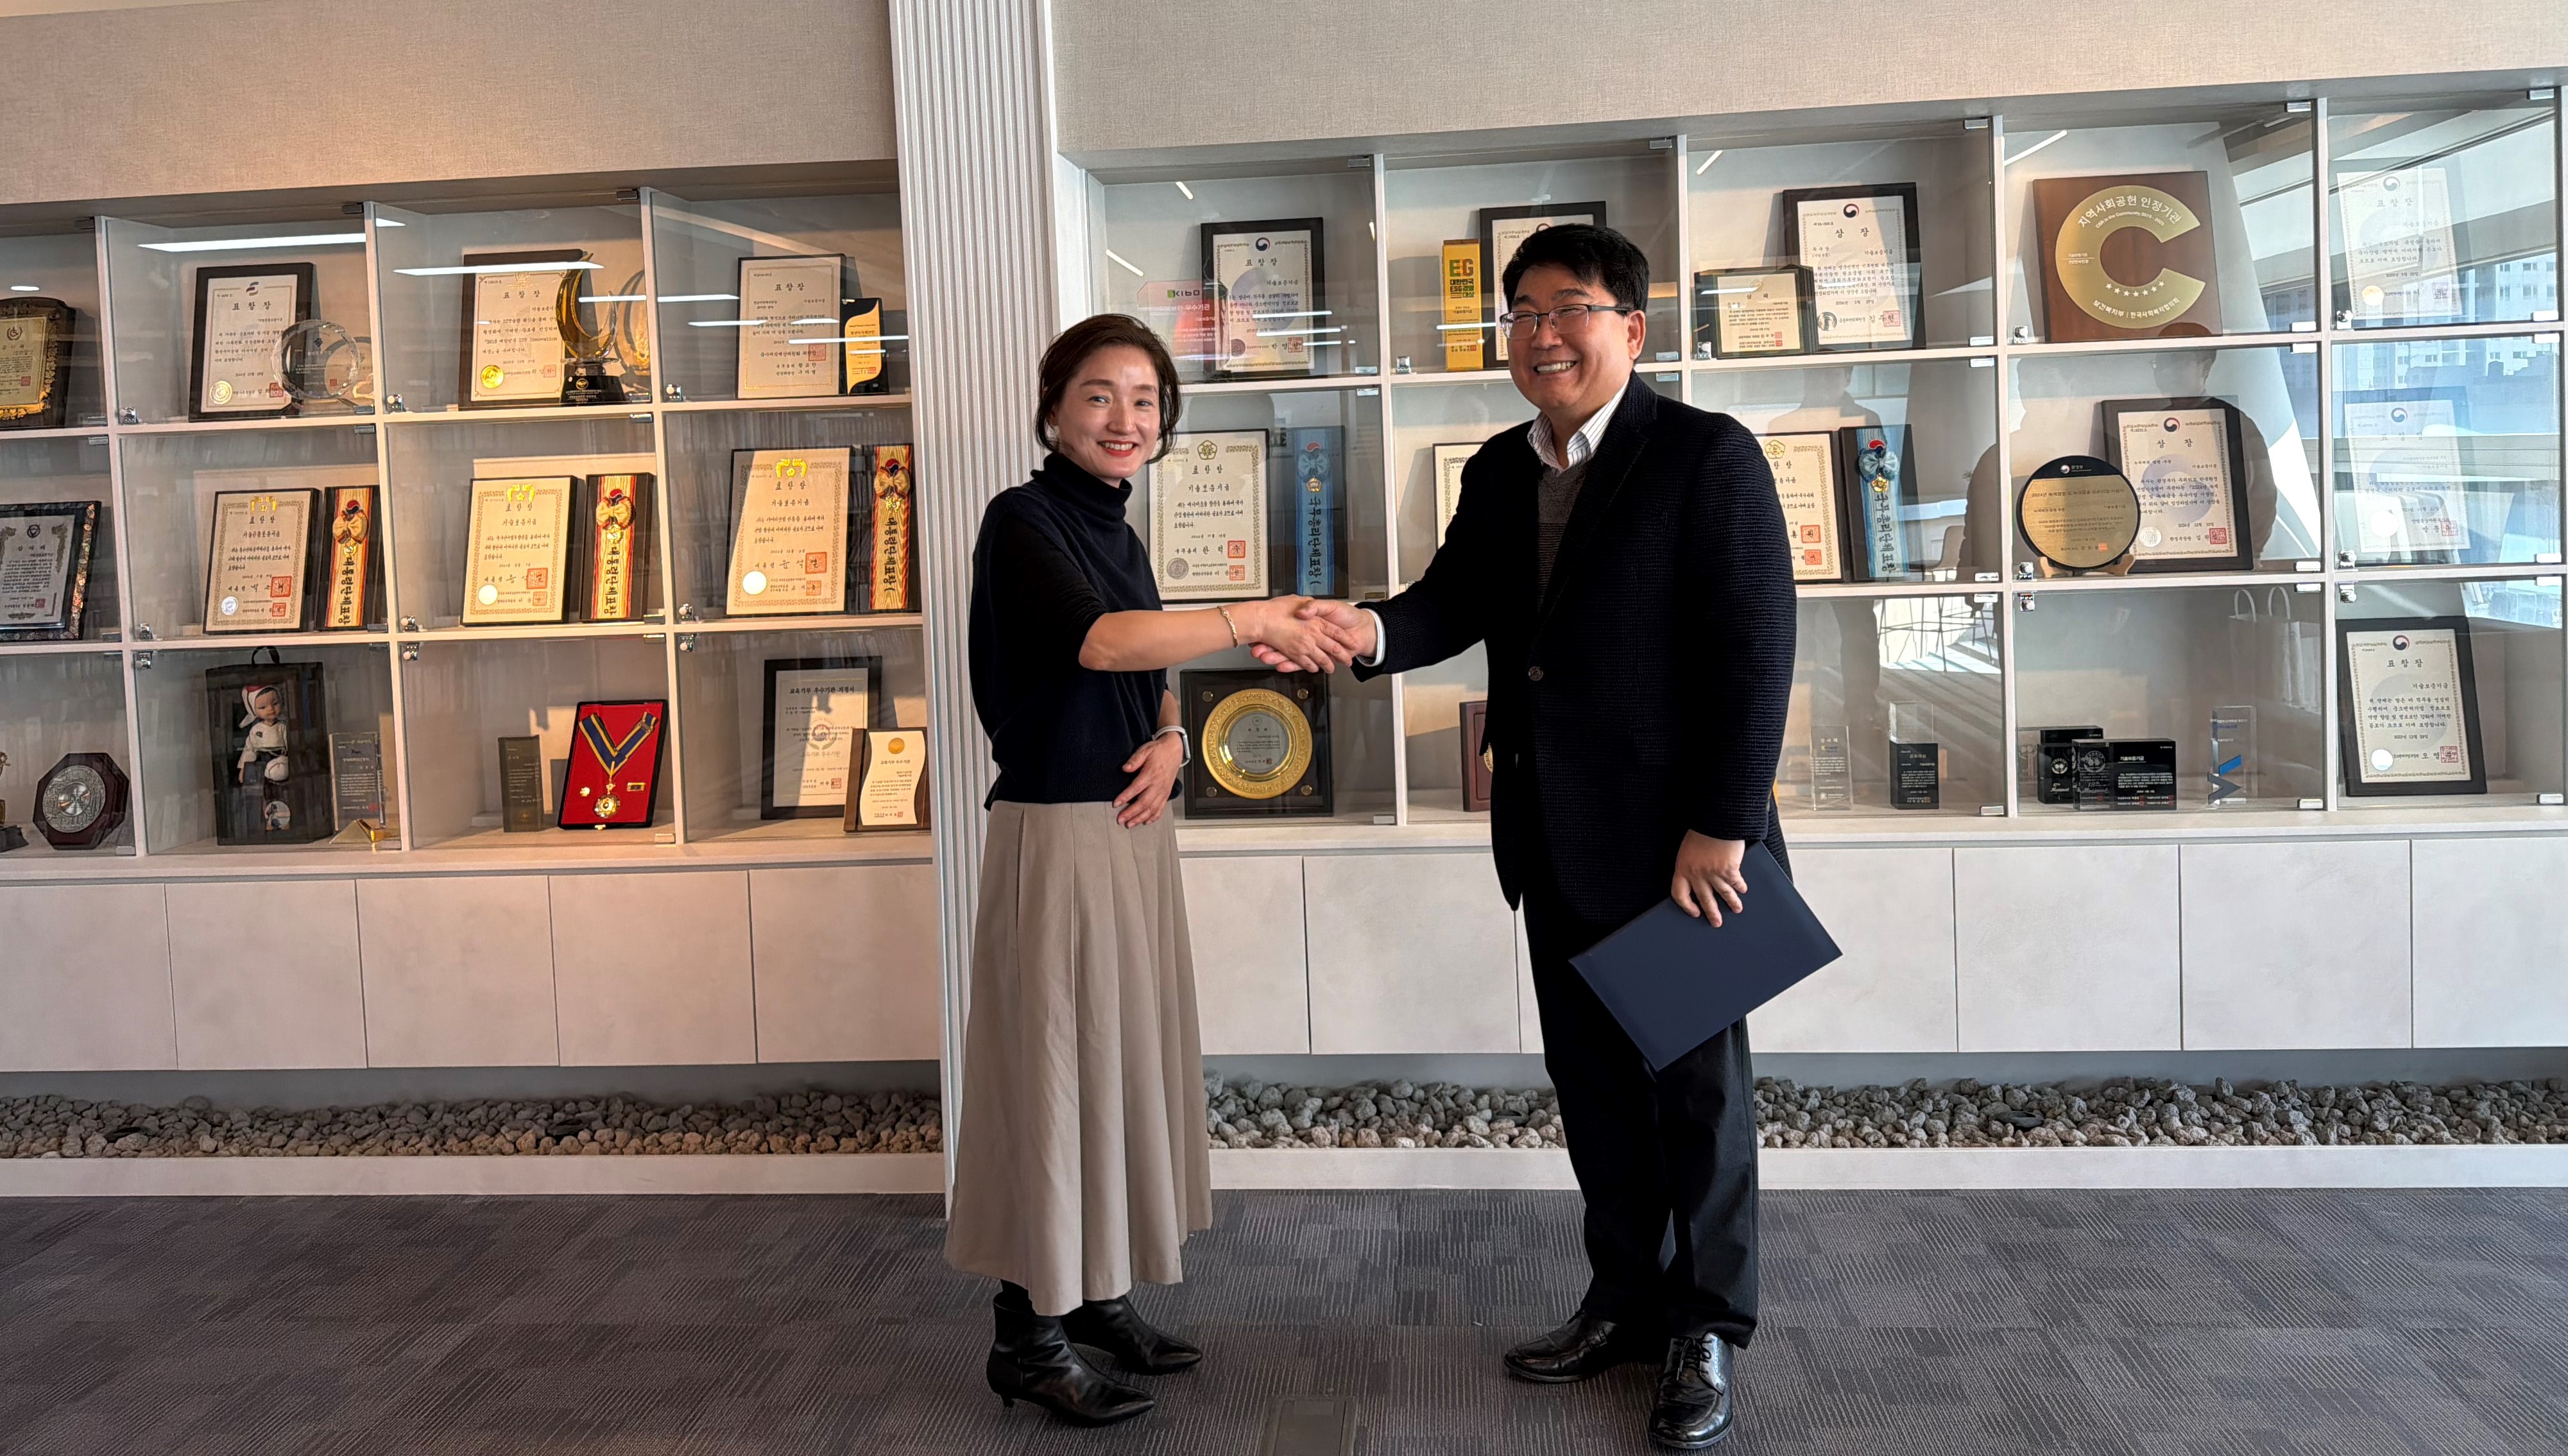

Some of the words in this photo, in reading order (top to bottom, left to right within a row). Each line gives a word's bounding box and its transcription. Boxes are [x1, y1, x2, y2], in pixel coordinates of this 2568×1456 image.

[2377, 198, 2413, 207] 표창장
[2077, 195, 2137, 228] 지역사회공헌
[2141, 197, 2182, 225] 인정기관
[2095, 219, 2105, 229] CSR
[1245, 257, 1278, 267] 표창장
[775, 282, 805, 291] 표창장
[503, 289, 540, 299] 표창장
[232, 300, 271, 311] 표창장
[2092, 299, 2125, 318] 보건복지부
[2130, 297, 2180, 319] 한국사회복지협의회
[2156, 438, 2193, 449] 상장
[1192, 463, 1223, 475] 표창장
[775, 480, 807, 490] 표창장
[1188, 483, 1230, 493] 기술보증기금
[506, 502, 533, 512] 표창장
[771, 498, 810, 507] 기술보증기금
[249, 515, 275, 524] 표창장
[1307, 496, 1323, 576] 국무총리단체표창
[1875, 494, 1897, 573] 국무총리단체표창
[883, 517, 898, 586] 대통령단체표창
[604, 546, 622, 617] 대통령단체표창
[337, 557, 357, 626] 대통령단체표창
[2386, 658, 2424, 669] 표창장
